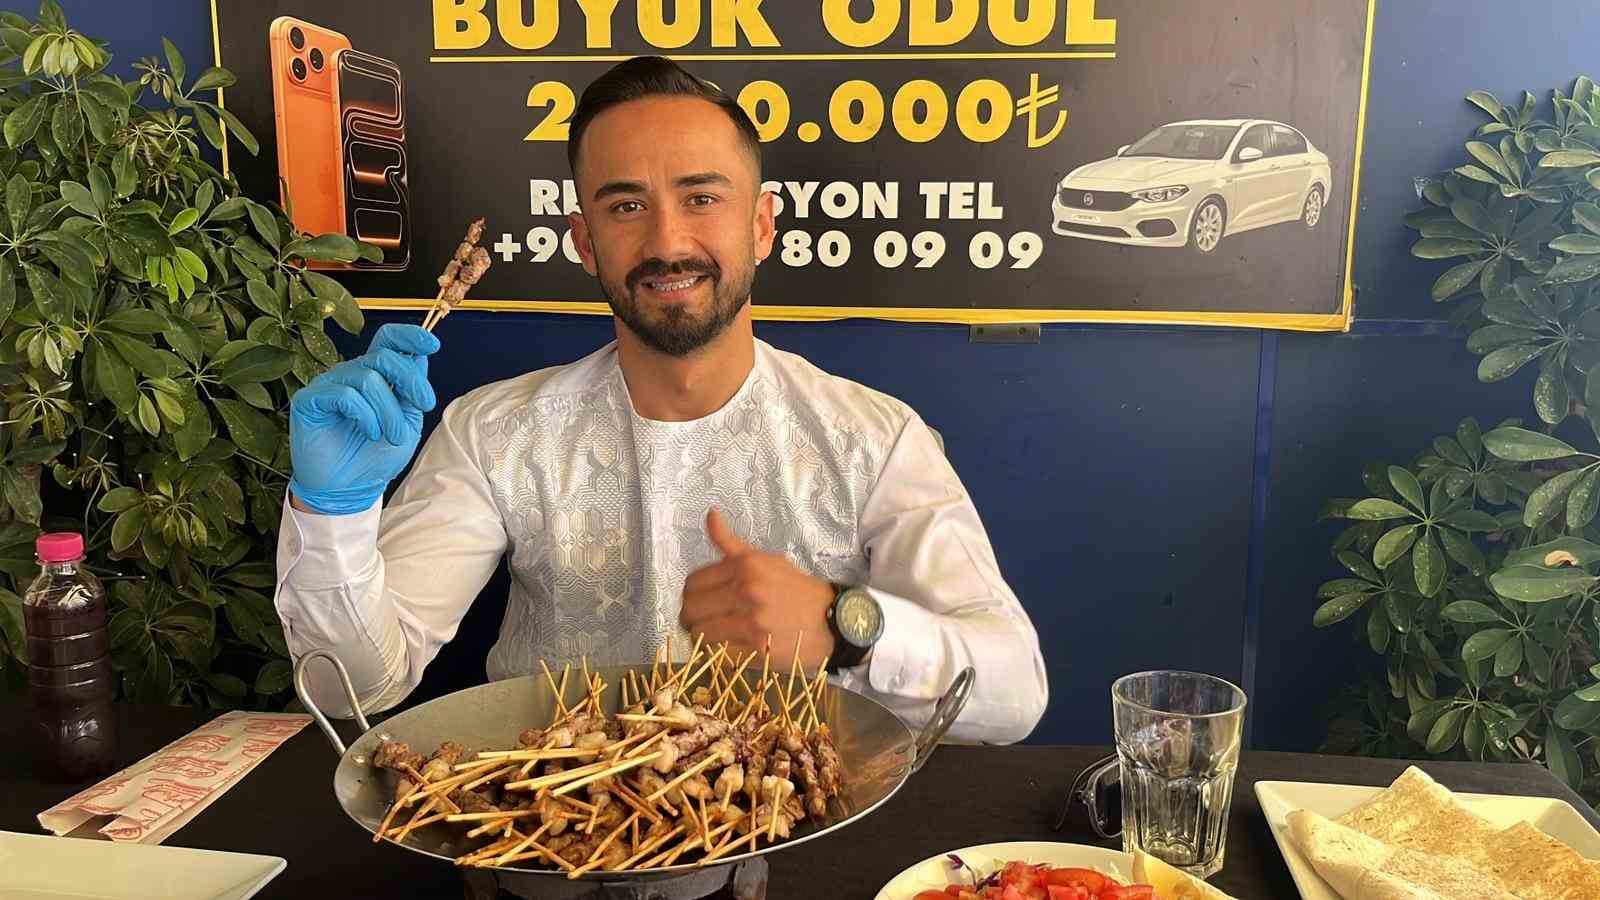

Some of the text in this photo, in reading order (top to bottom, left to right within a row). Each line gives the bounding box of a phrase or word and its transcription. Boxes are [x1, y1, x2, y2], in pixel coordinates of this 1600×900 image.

[523, 72, 1068, 148] 20.000₺
[919, 181, 1004, 220] TEL
[494, 226, 1044, 270] +9 80 09 09
